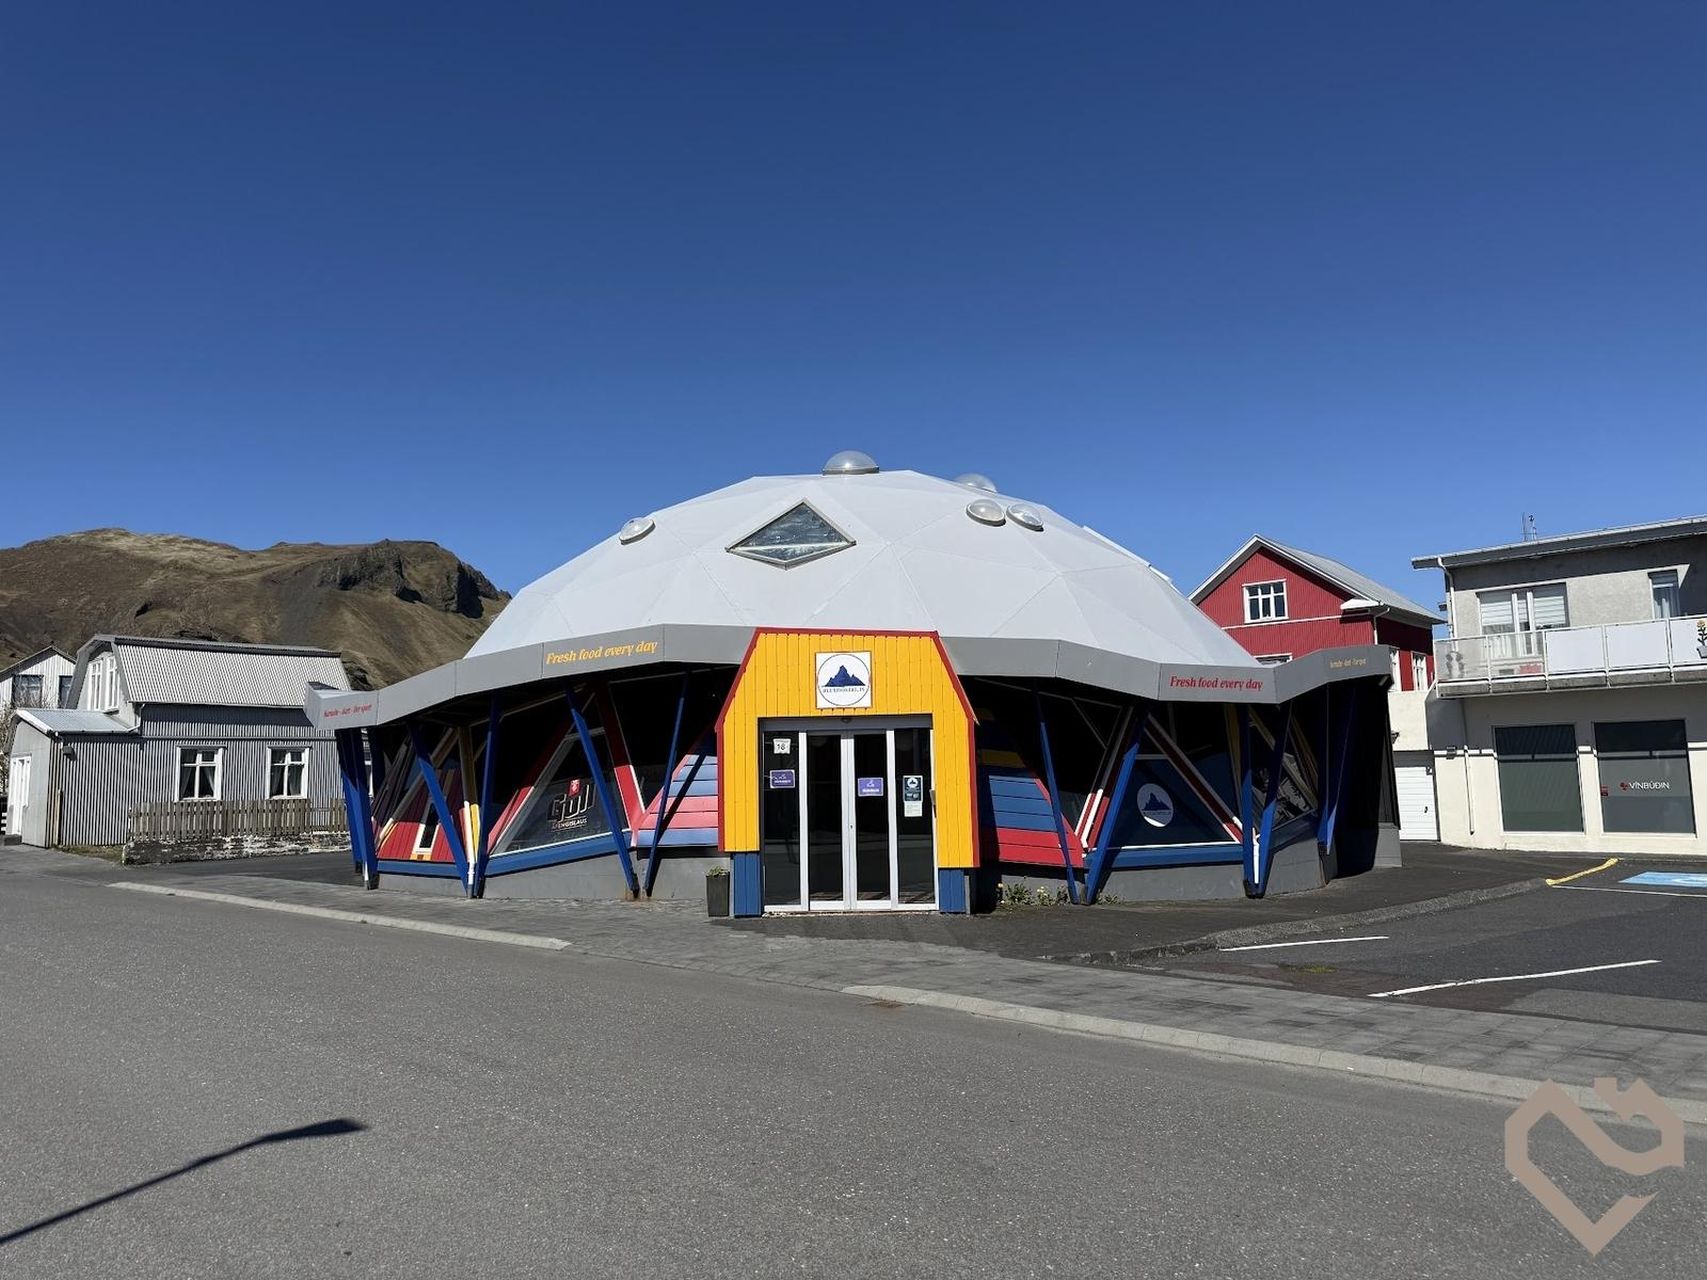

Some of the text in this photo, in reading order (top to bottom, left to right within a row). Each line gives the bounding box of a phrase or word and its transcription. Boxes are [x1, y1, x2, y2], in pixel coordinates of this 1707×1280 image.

[546, 640, 658, 664] Fresh food every day
[1170, 675, 1263, 691] Fresh food every day
